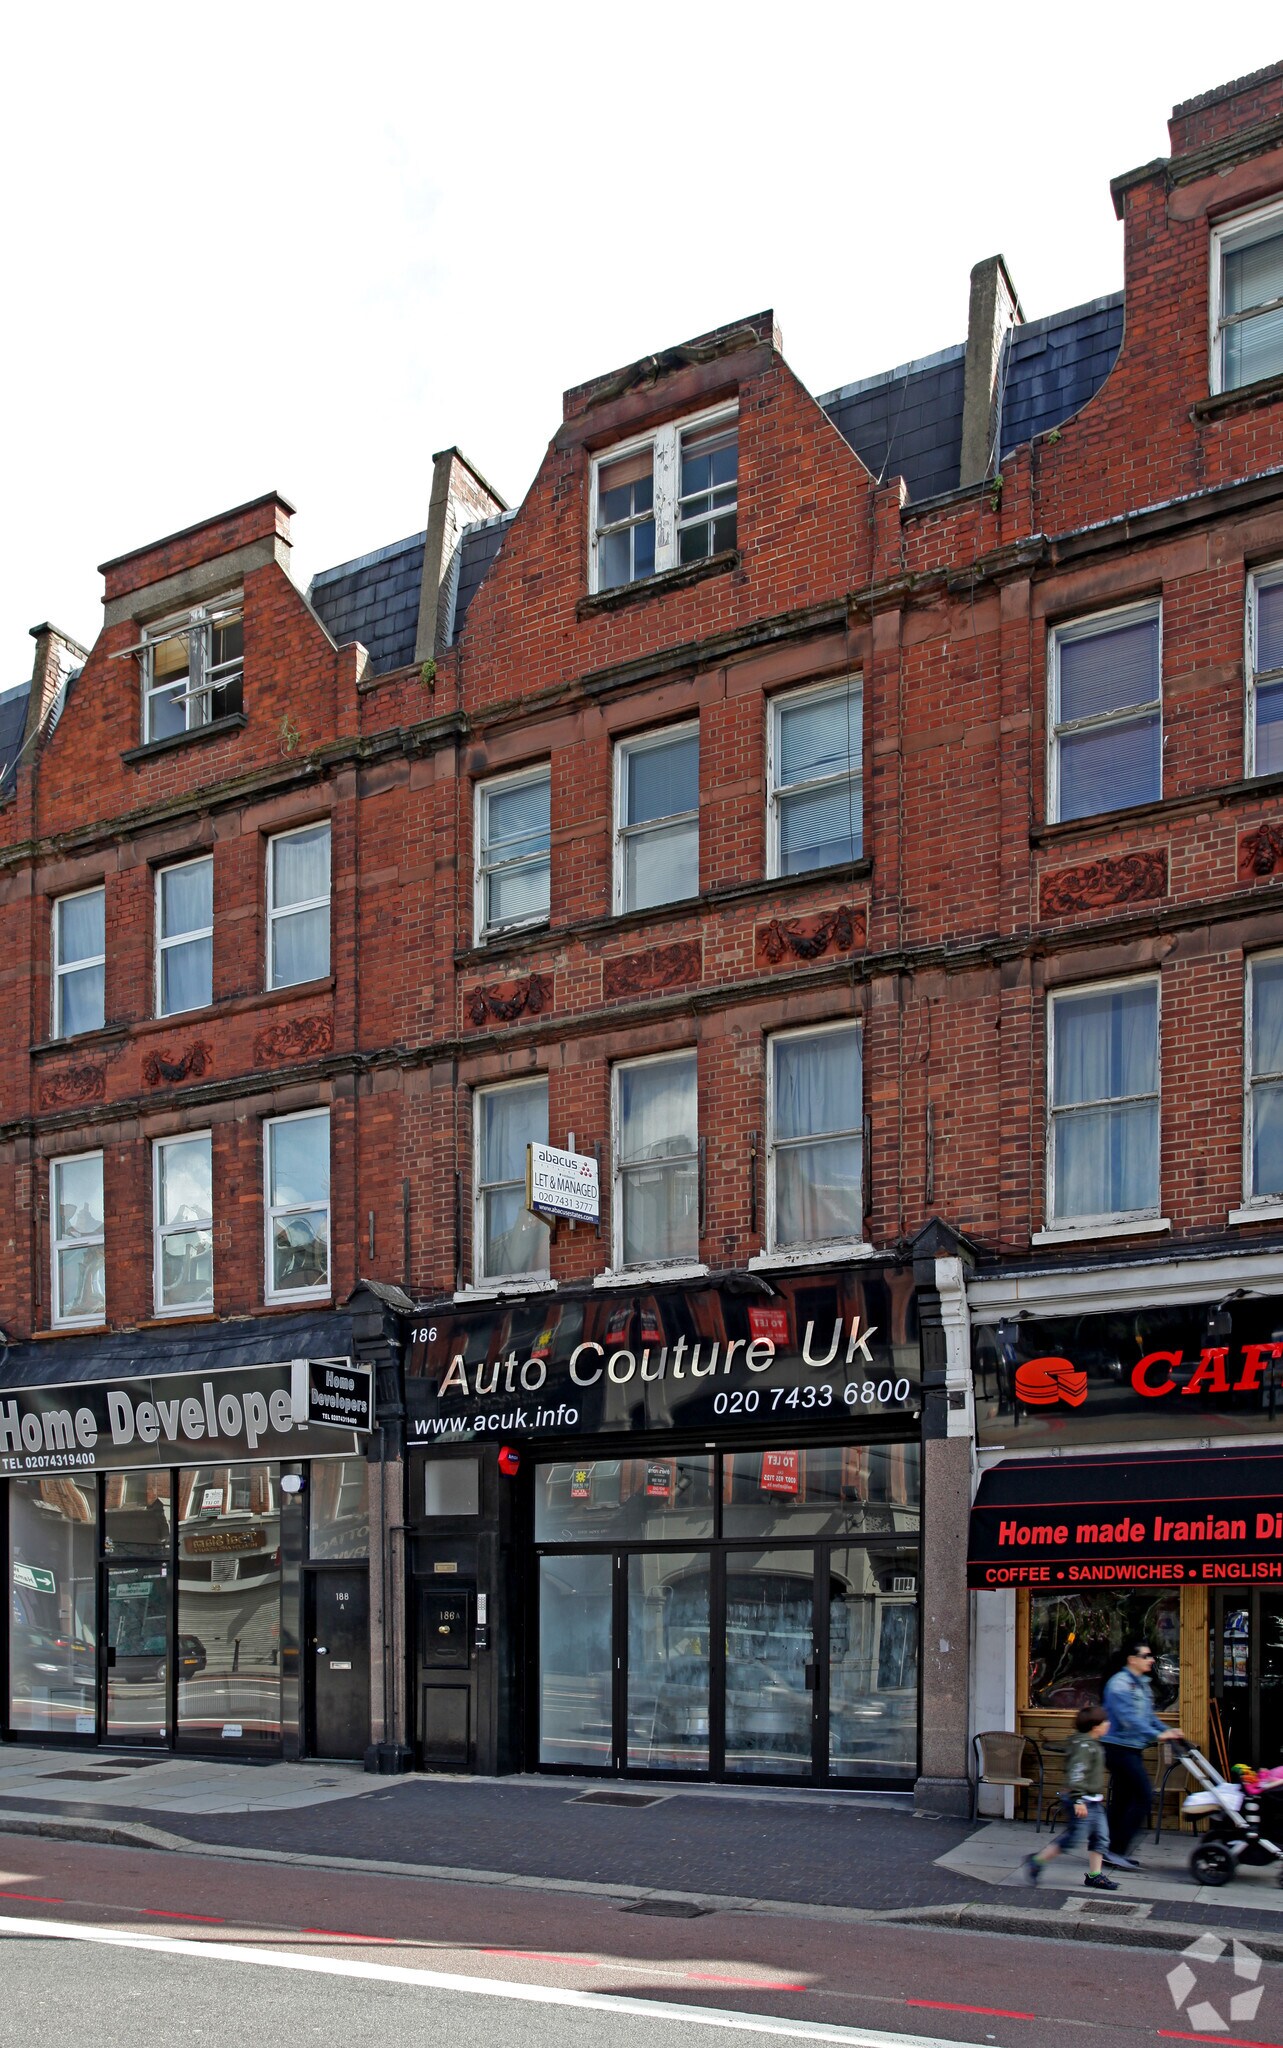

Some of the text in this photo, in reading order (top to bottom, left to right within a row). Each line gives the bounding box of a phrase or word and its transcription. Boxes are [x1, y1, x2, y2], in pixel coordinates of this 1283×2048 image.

[538, 1150, 578, 1170] abacus
[534, 1172, 598, 1199] LET & MANAGED
[538, 1191, 593, 1212] 020 7431 3777
[410, 1326, 438, 1344] 186
[437, 1315, 879, 1399] Auto Couture Uk
[325, 1370, 355, 1391] Home
[1130, 1342, 1283, 1398] CAF
[311, 1388, 368, 1413] Developers
[713, 1377, 910, 1415] 020 7433 6800
[0, 1399, 98, 1452] Home
[321, 1412, 330, 1420] TEL
[414, 1404, 580, 1436] www.acuk.info
[3, 1452, 96, 1470] TEL 02074319400
[998, 1520, 1069, 1546] Home
[1075, 1517, 1146, 1543] made
[1153, 1514, 1246, 1542] Iranian
[985, 1562, 1281, 1583] COFFEE SANDWICHES ENGLISH
[335, 1592, 349, 1601] 188
